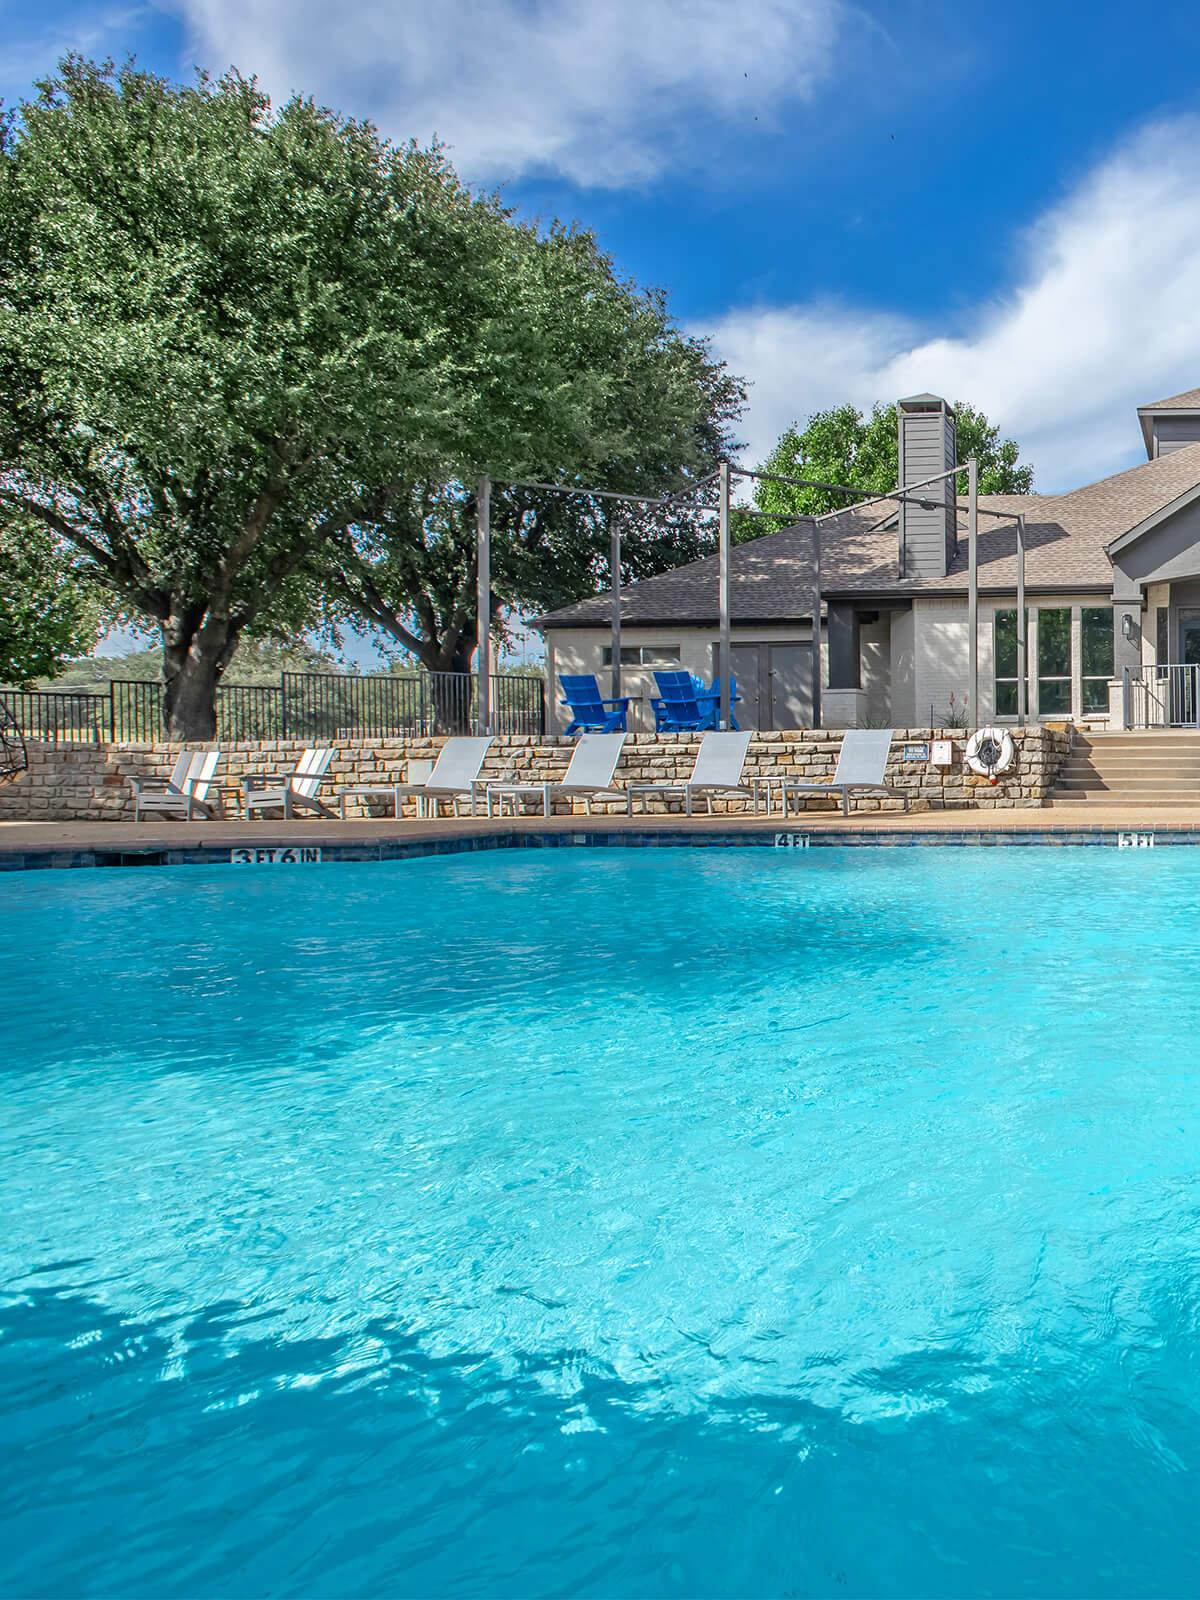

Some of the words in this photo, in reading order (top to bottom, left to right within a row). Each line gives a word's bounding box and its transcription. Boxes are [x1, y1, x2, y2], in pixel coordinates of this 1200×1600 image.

[778, 834, 790, 847] 4
[793, 834, 809, 848] FT
[1121, 833, 1133, 846] 5
[1137, 833, 1153, 846] FT
[235, 849, 252, 864] 3
[256, 849, 276, 864] FT
[281, 848, 296, 864] 6
[300, 849, 318, 862] IN
